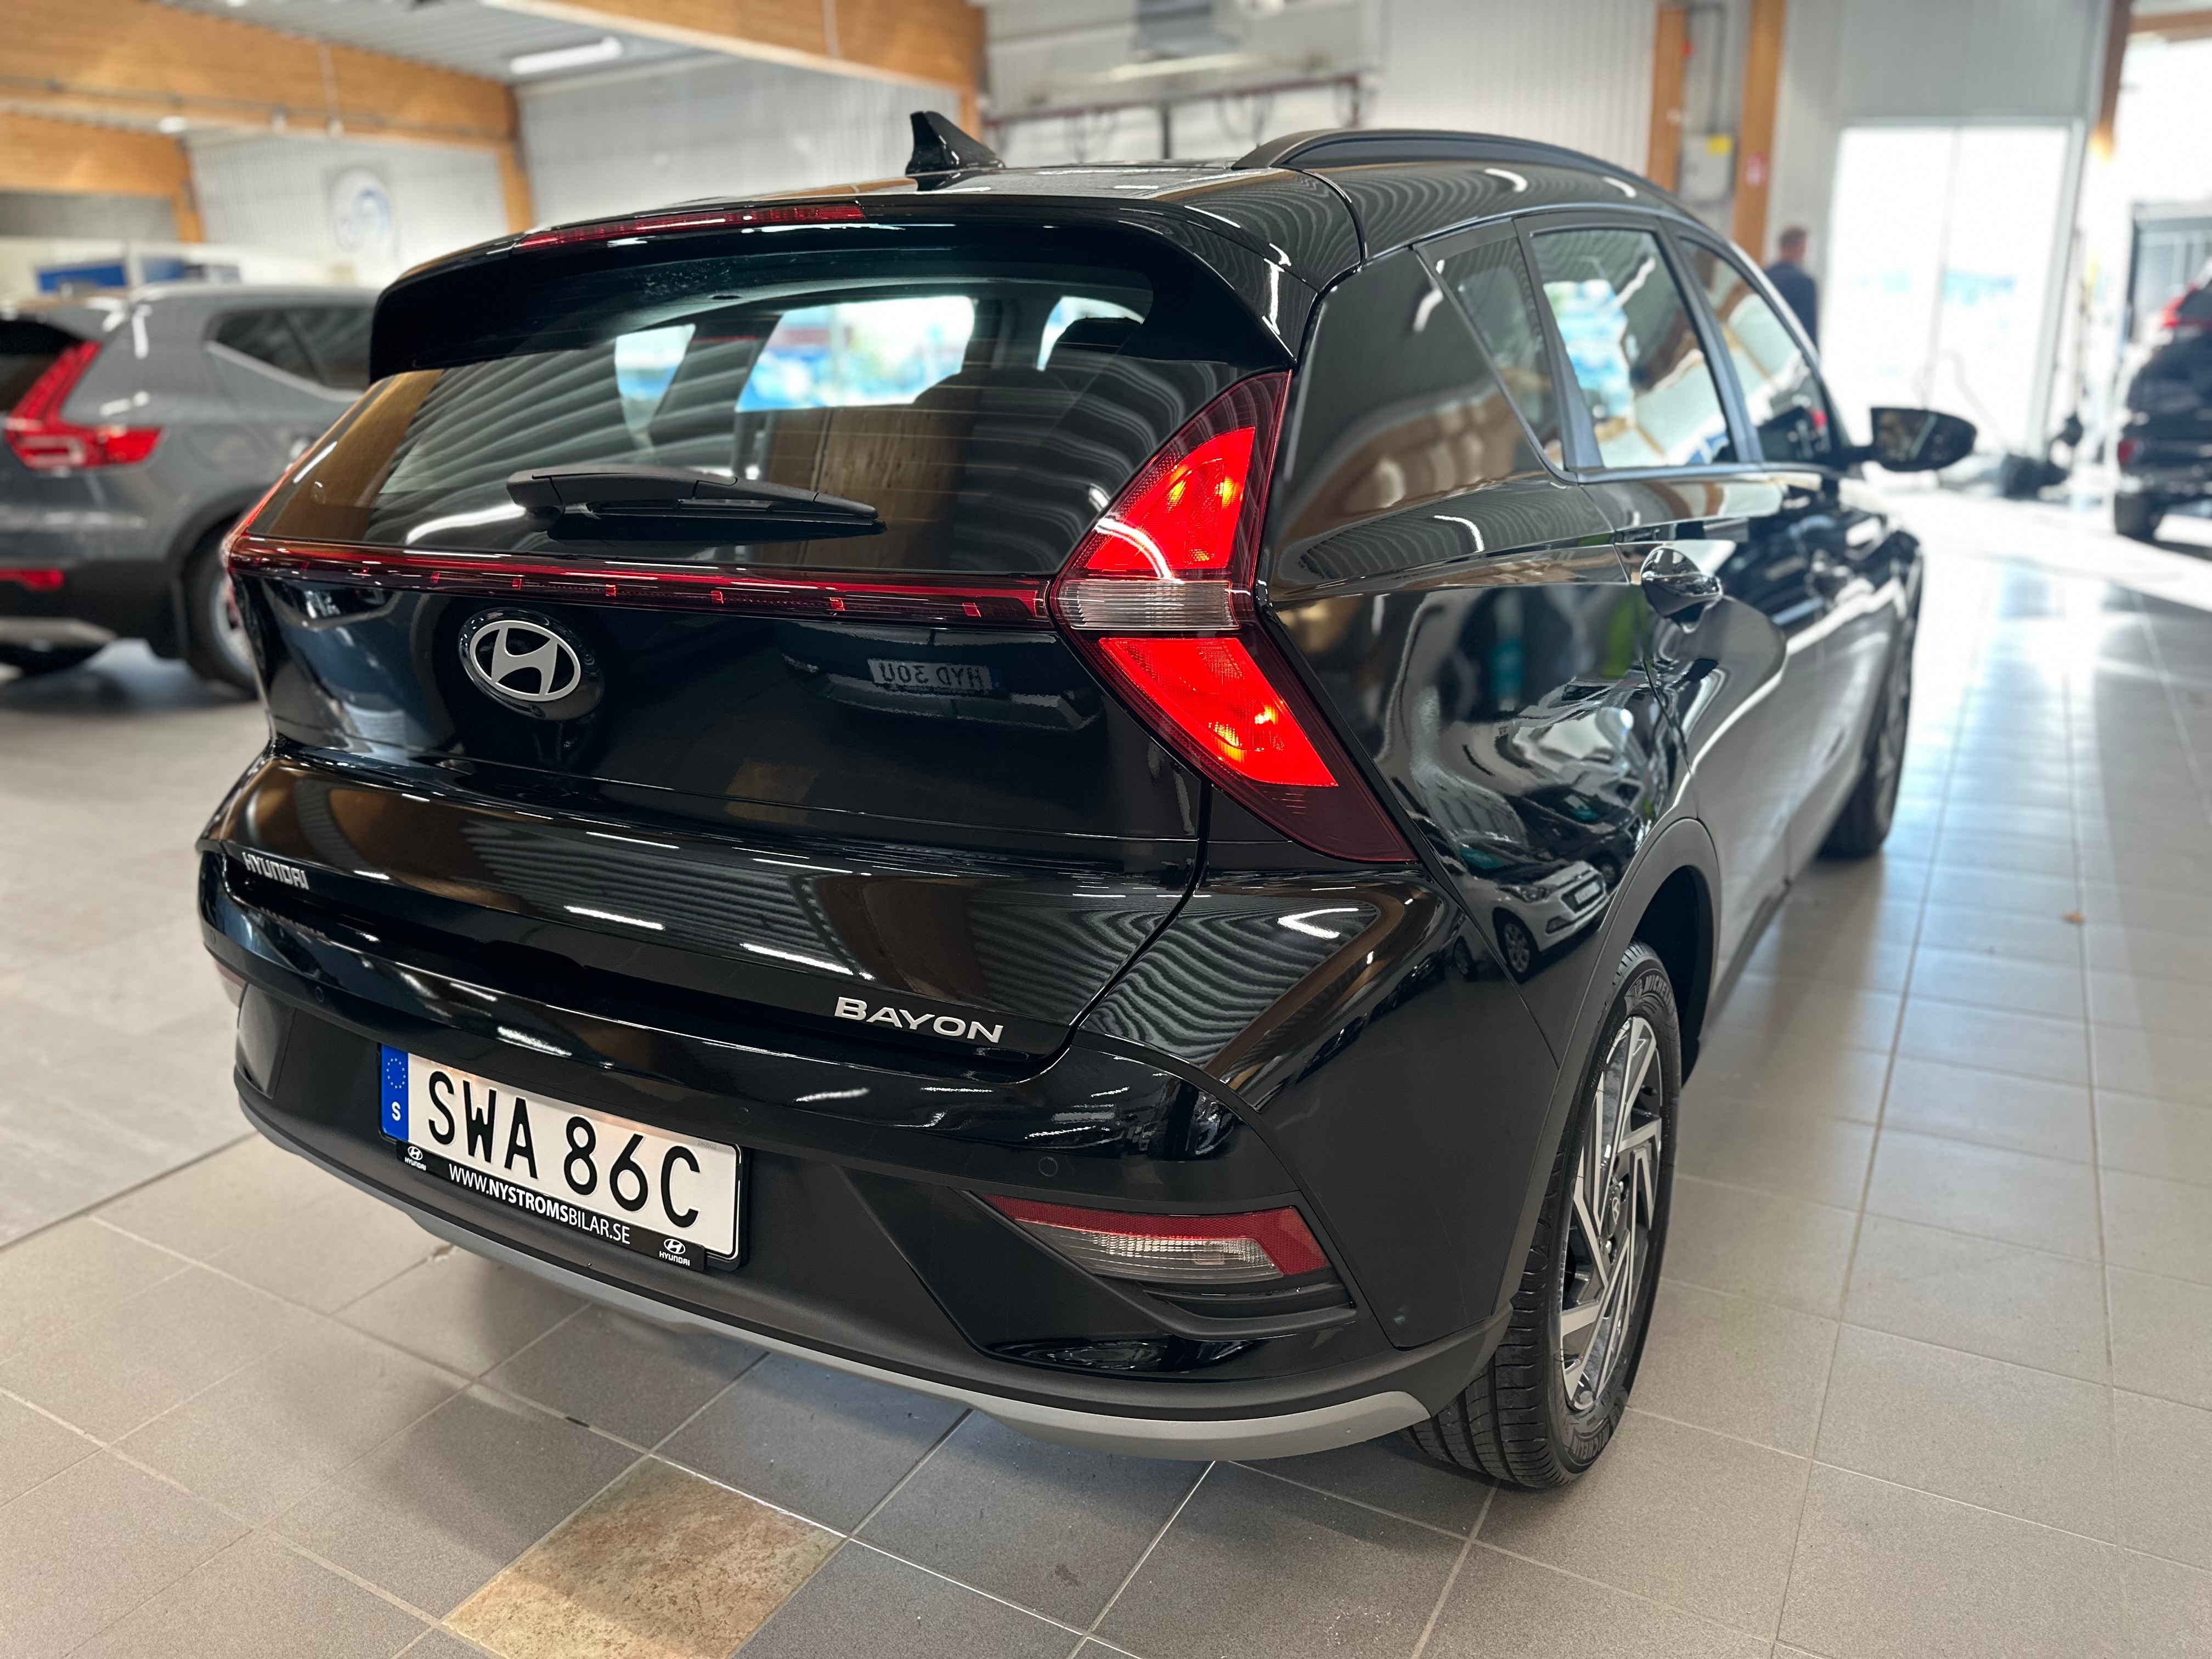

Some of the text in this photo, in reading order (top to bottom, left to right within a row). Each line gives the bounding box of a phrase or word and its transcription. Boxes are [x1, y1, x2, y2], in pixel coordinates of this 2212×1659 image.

[241, 851, 309, 890] HYUNDAI
[834, 996, 1003, 1043] BAYON
[391, 1102, 402, 1121] S
[404, 1156, 426, 1171] HYUNDAI
[428, 1070, 701, 1228] SWA 86C
[449, 1163, 630, 1245] WWW.NYSTROMSBILAR.SE
[659, 1250, 690, 1266] HYUNDAI
